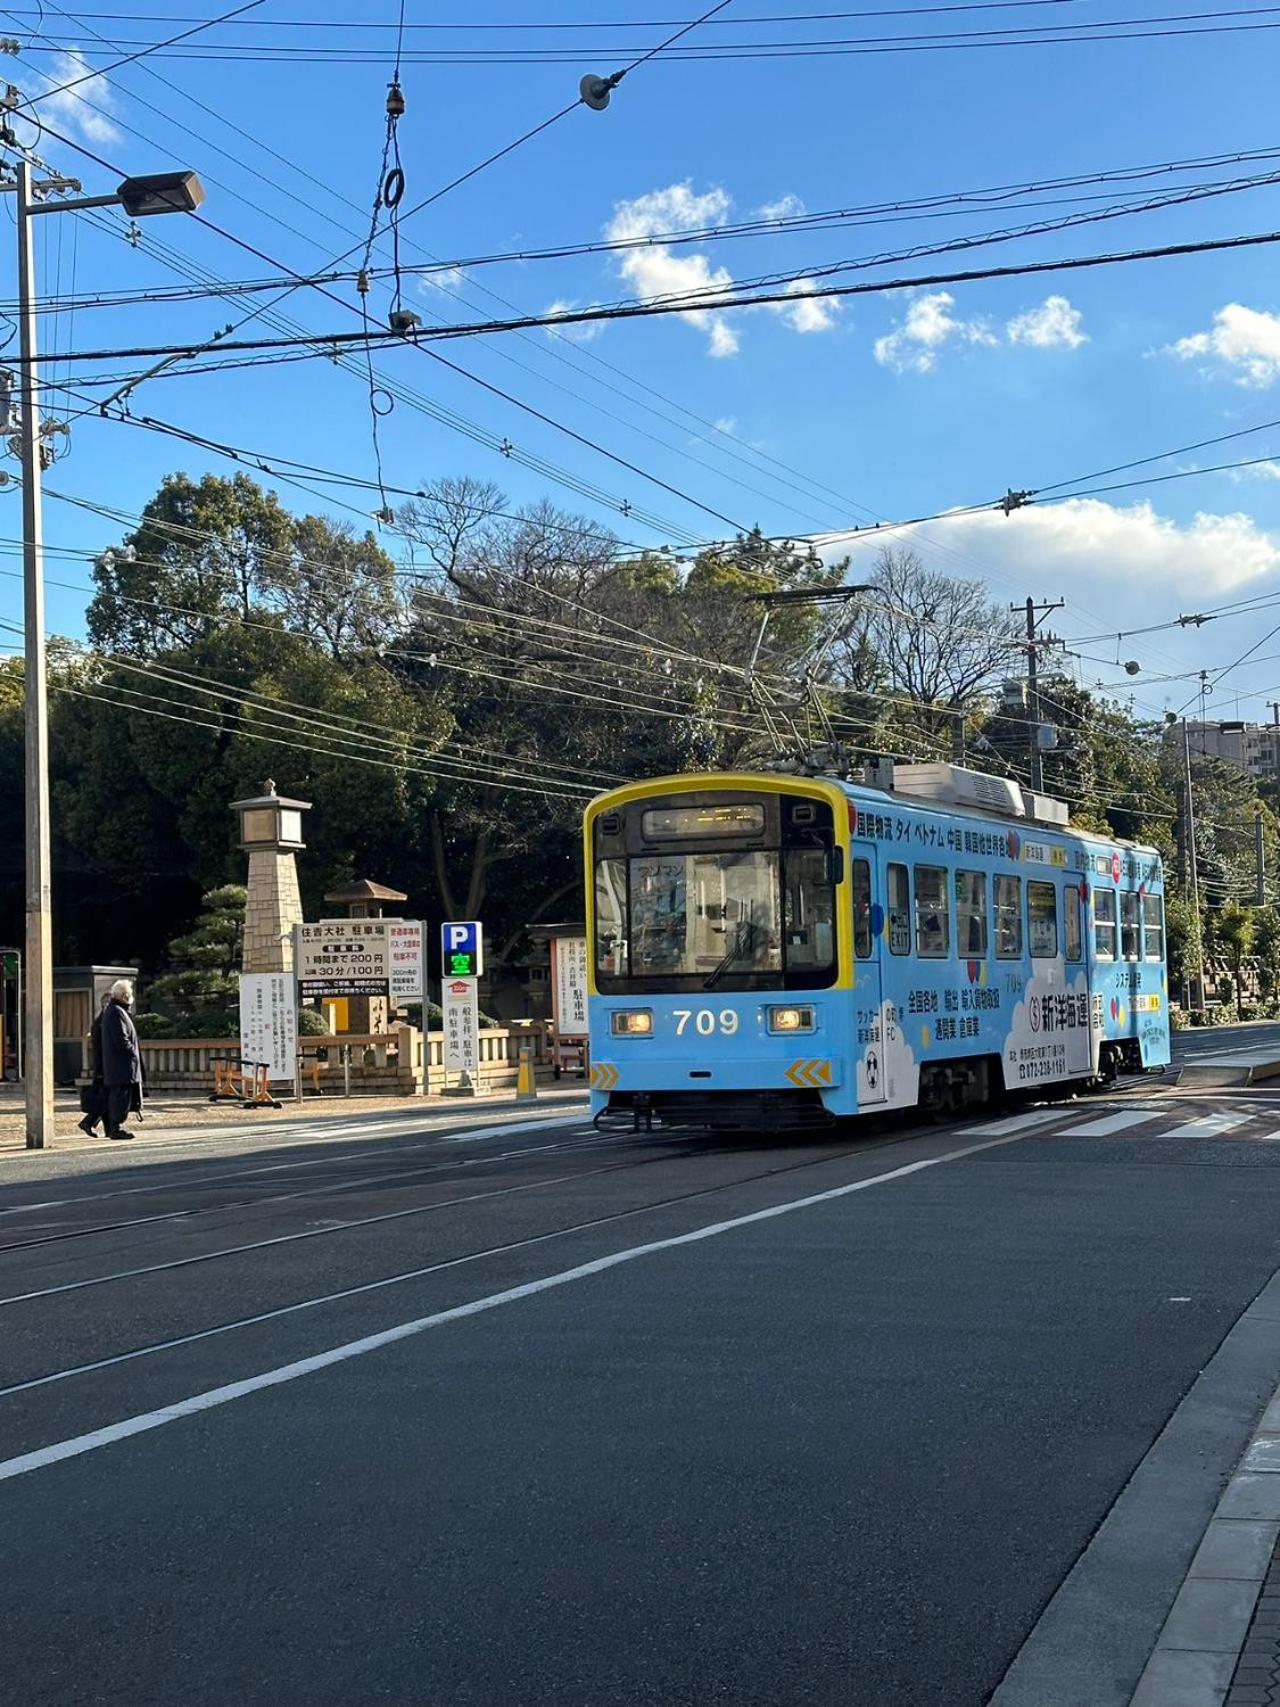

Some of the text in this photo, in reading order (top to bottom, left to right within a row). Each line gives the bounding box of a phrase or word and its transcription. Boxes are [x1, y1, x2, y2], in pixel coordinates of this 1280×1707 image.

[857, 811, 893, 841] 国際物流
[896, 818, 912, 844] タイ
[915, 821, 945, 848] ベトナム
[948, 828, 962, 852] 中国
[302, 925, 384, 937] 住吉大社 駐車場
[451, 926, 468, 950] P
[451, 953, 470, 975] 空
[573, 989, 585, 1022] 駐車場
[908, 989, 938, 1014] 全国各地
[944, 989, 959, 1012] 輸出
[1041, 993, 1088, 1032] 新洋海運
[672, 1009, 740, 1037] 709
